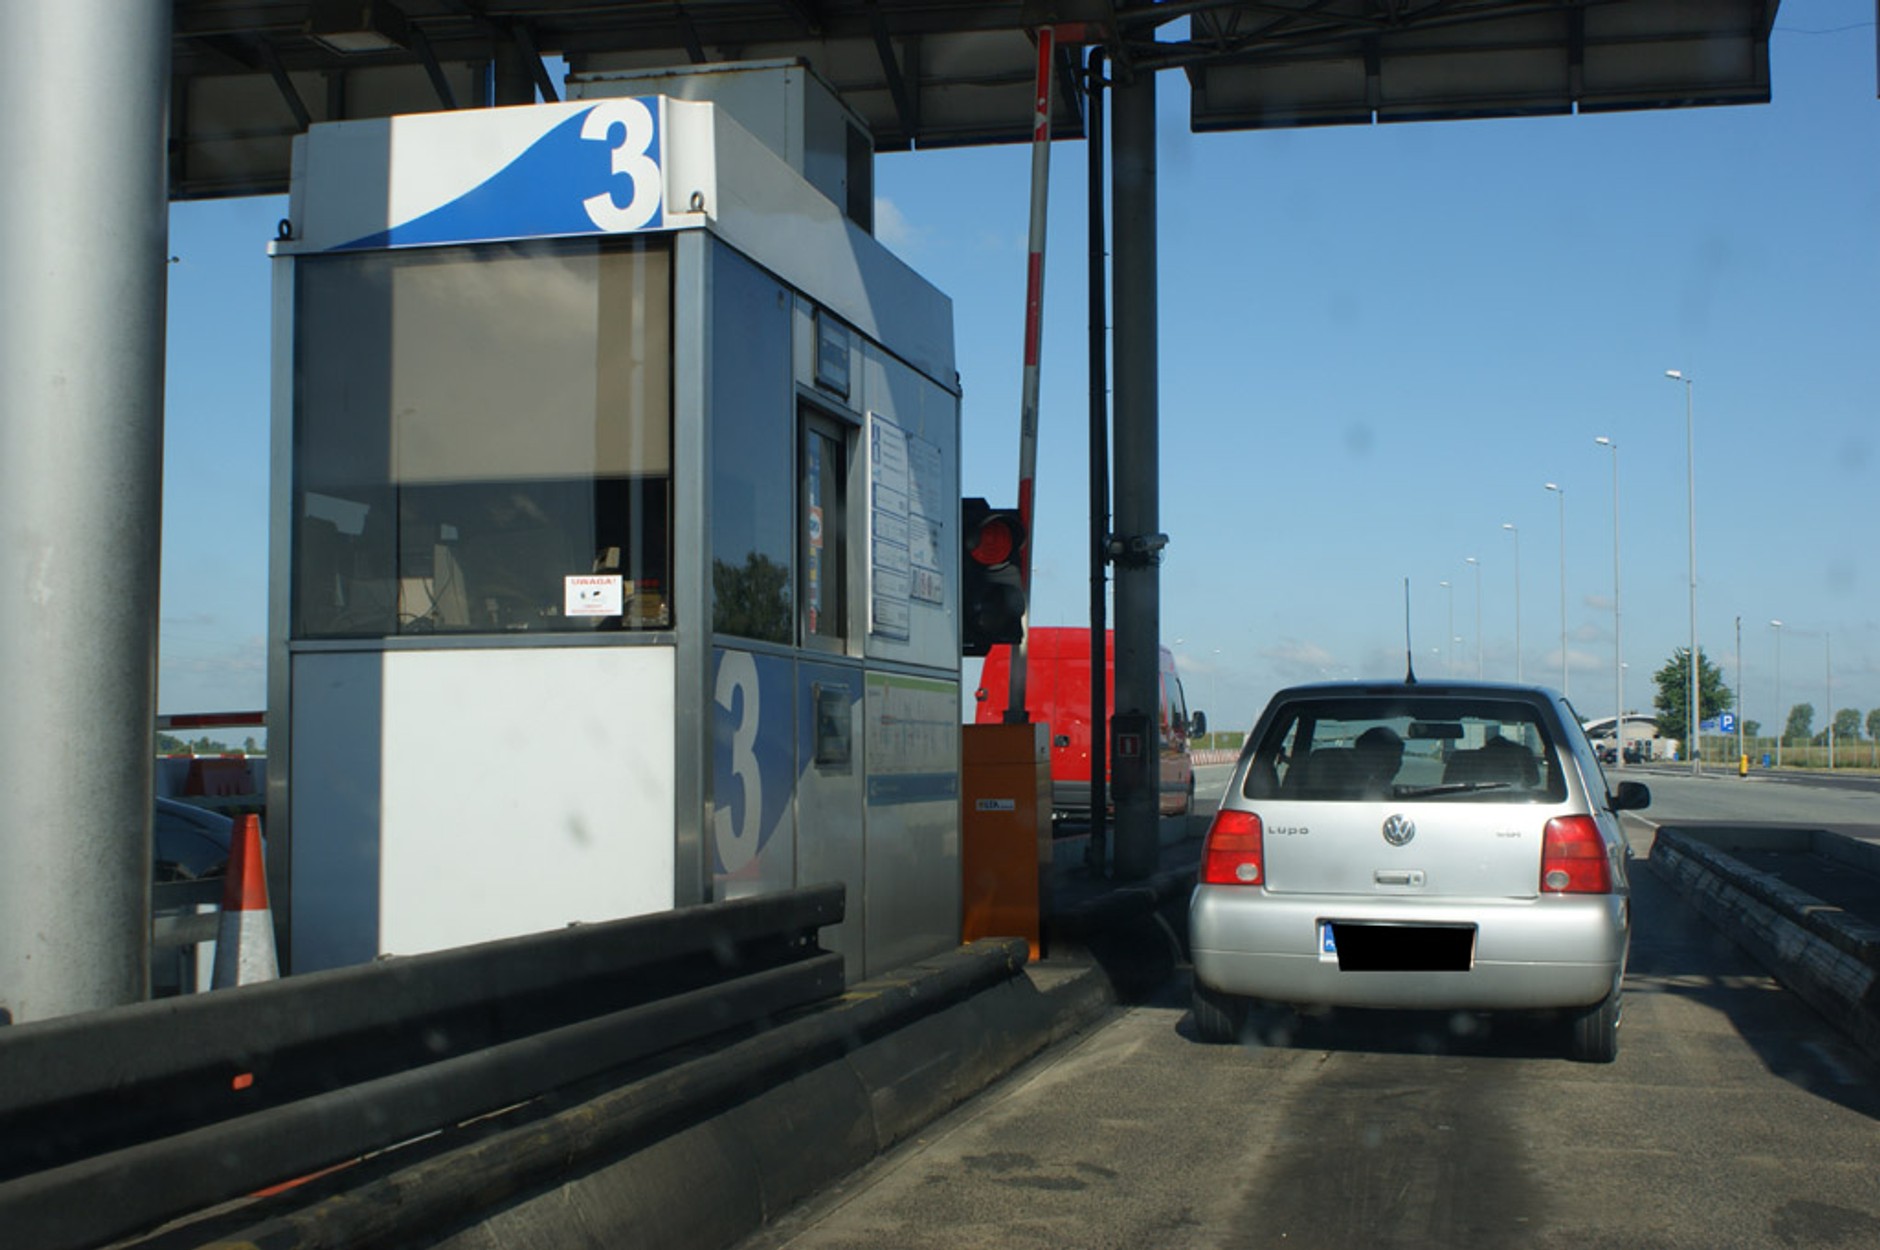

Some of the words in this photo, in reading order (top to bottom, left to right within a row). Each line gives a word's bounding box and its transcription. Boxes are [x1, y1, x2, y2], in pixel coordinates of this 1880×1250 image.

[581, 97, 662, 233] 3
[713, 650, 762, 875] 3
[1724, 715, 1733, 727] P
